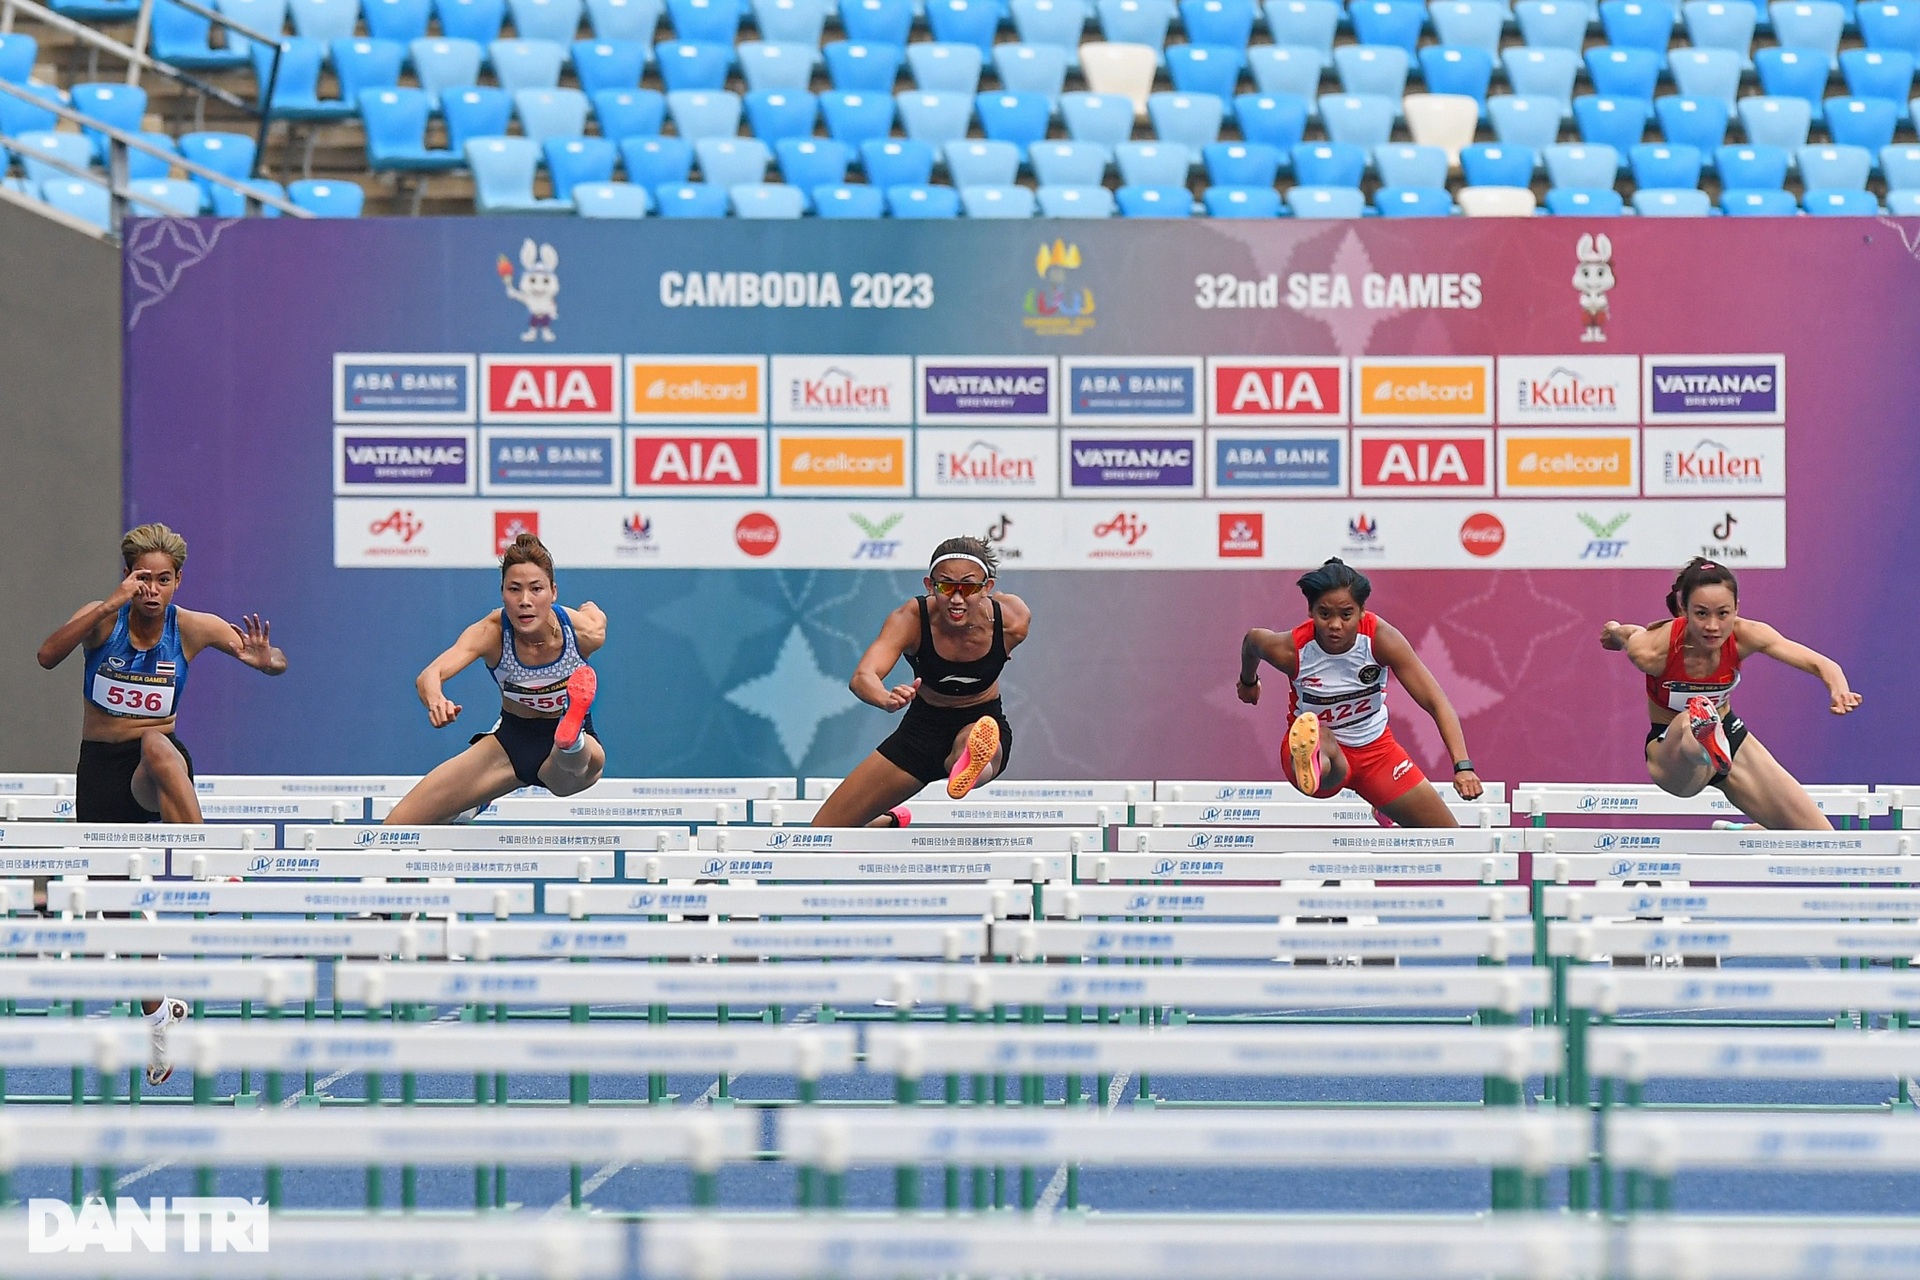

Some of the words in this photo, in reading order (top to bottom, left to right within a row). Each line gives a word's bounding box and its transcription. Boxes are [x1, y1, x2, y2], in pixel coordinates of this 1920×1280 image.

[660, 271, 842, 307] CAMBODIA
[851, 272, 934, 308] 2023
[1195, 273, 1278, 308] 32nd
[1287, 273, 1353, 308] SEA
[1362, 273, 1482, 308] GAMES
[353, 373, 395, 390] ABA
[402, 373, 458, 390] BANK
[504, 370, 598, 408] AIA
[666, 379, 747, 401] cellcard
[928, 375, 1045, 396] VATTANAC
[1080, 376, 1121, 393] ABA
[1128, 376, 1185, 393] BANK
[1655, 374, 1773, 394] VATTANAC
[804, 378, 889, 406] Kulen
[1232, 372, 1324, 411] AIA
[1392, 381, 1473, 402] cellcard
[1532, 378, 1615, 406] Kulen
[346, 446, 464, 465] VATTANAC
[498, 447, 539, 464] ABA
[546, 447, 604, 464] BANK
[650, 443, 742, 481] AIA
[812, 452, 893, 473] cellcard
[950, 451, 1034, 478] Kulen
[1073, 448, 1191, 467] VATTANAC
[1225, 447, 1266, 465] ABA
[1274, 447, 1330, 465] BANK
[1377, 443, 1469, 482] AIA
[1539, 451, 1619, 473] cellcard
[1677, 449, 1761, 478] Kulen
[130, 675, 143, 683] SEA
[143, 676, 168, 684] GAMES
[106, 686, 163, 711] 536
[1318, 699, 1372, 723] 422
[1600, 797, 1639, 806] 金陵体育
[1223, 808, 1261, 817] 金陵体育
[83, 832, 206, 842] 中国田径协会田径器材类官方供应商
[379, 832, 421, 841] 金陵体育
[499, 835, 621, 845] 中国田径协会田径器材类官方供应商
[792, 834, 833, 843] 金陵体育
[911, 837, 1034, 846] 中国田径协会田径器材类官方供应商
[1214, 835, 1255, 844] 金陵体育
[1332, 838, 1455, 847] 中国田径协会田径器材类官方供应商
[1620, 836, 1661, 845] 金陵体育
[275, 858, 320, 867] 金陵体育
[405, 862, 539, 872] 中国田径协会田径器材类官方供应商
[729, 860, 773, 870] 金陵体育
[858, 863, 991, 873] 中国田径协会田径器材类官方供应商
[1180, 861, 1224, 870] 金陵体育
